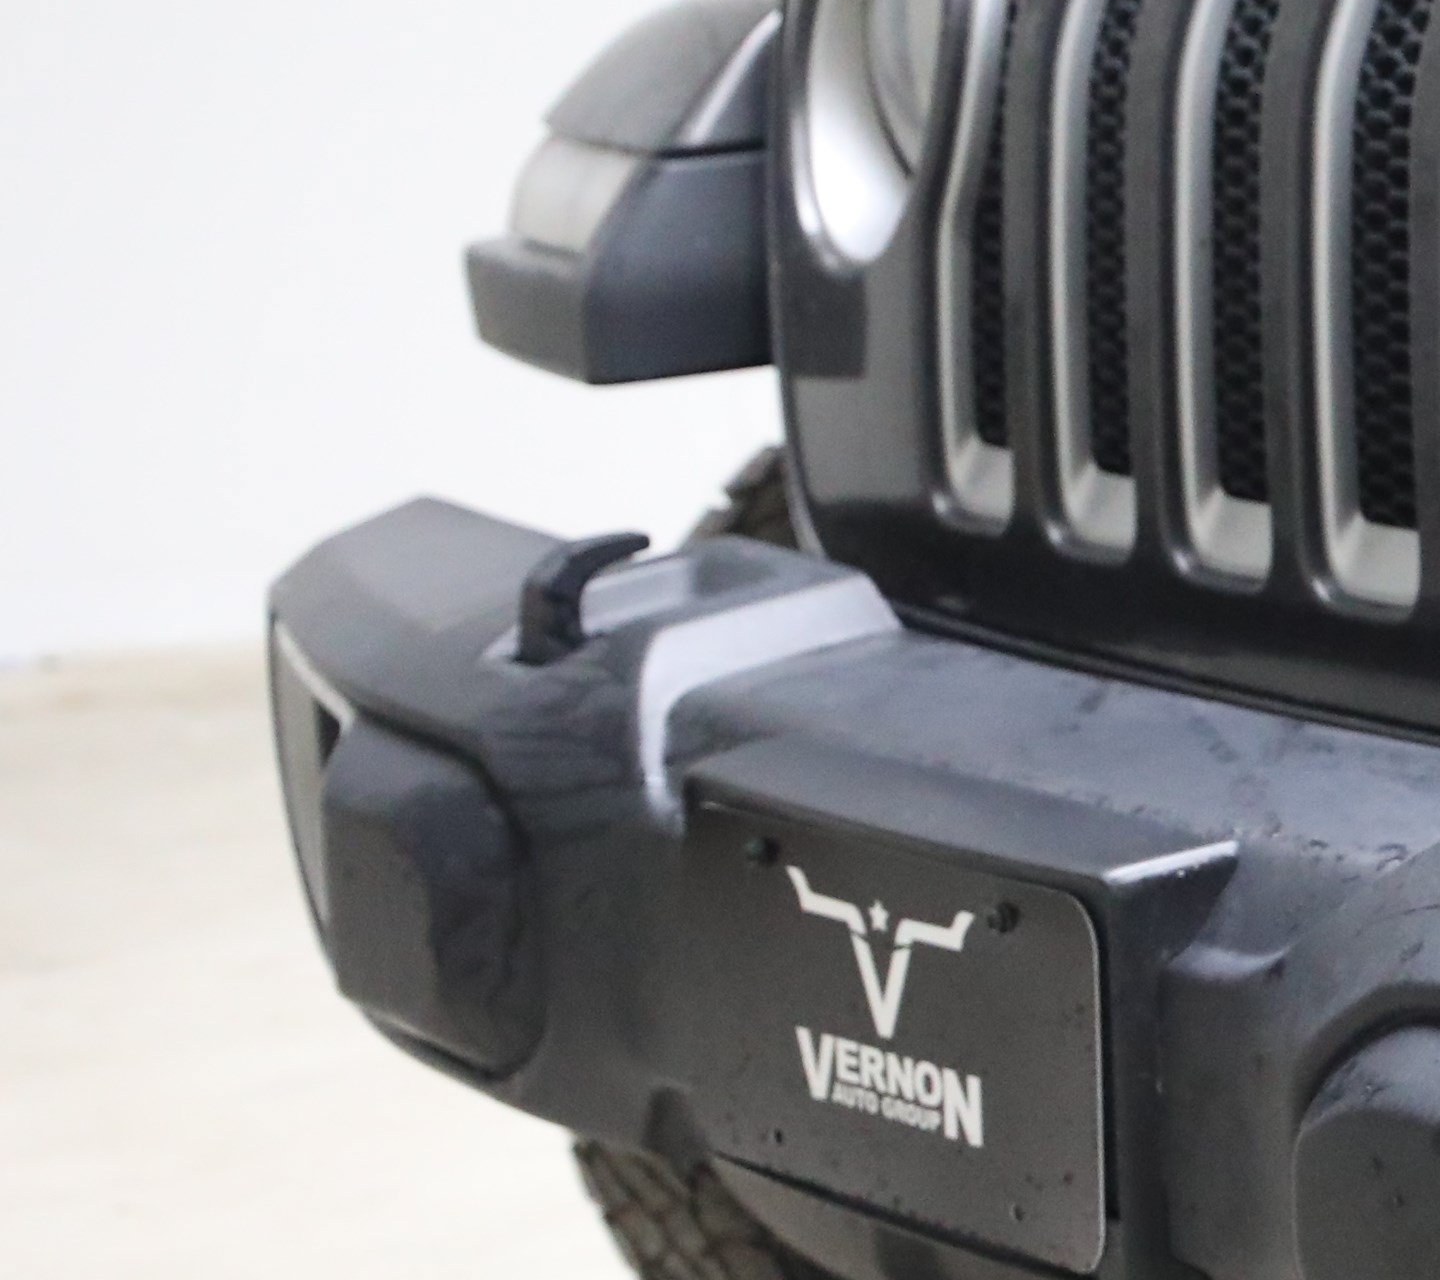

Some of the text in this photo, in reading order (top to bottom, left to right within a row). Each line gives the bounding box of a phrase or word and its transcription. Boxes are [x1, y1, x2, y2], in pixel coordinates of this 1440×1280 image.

[795, 1025, 984, 1149] VERNON
[831, 1081, 942, 1132] AUTO GROUP
